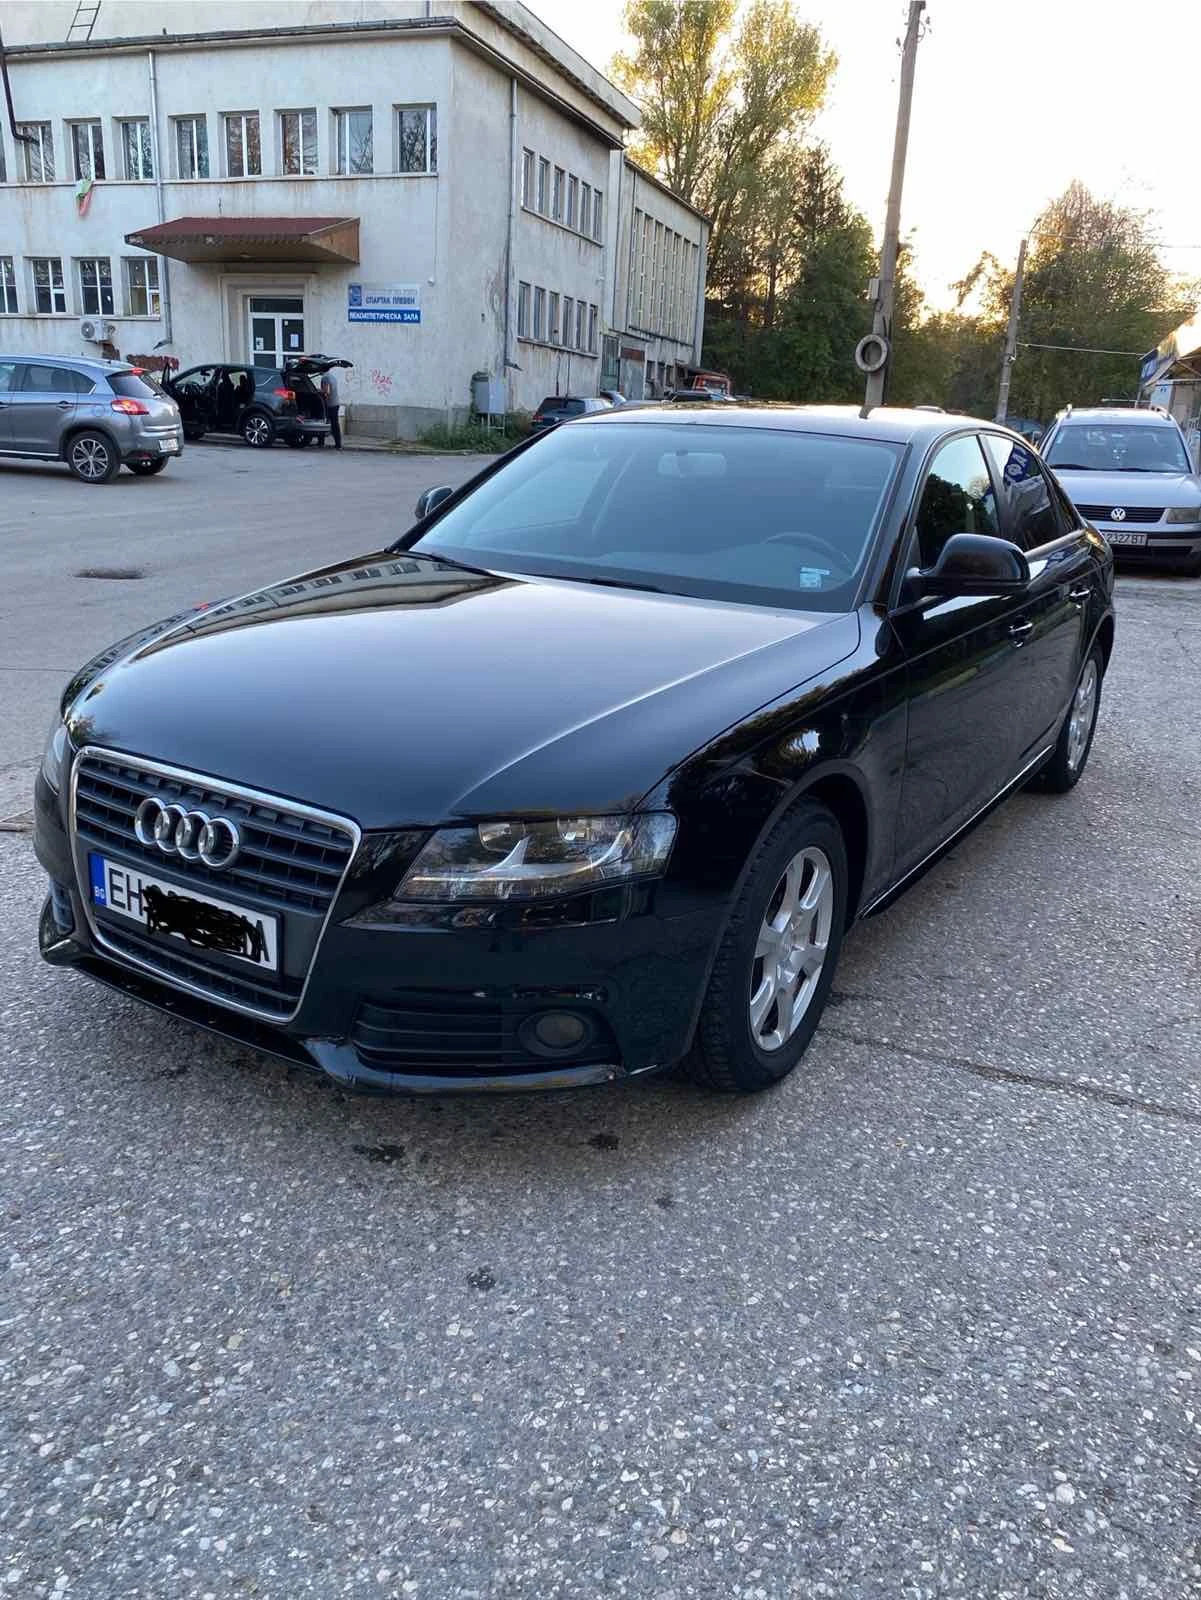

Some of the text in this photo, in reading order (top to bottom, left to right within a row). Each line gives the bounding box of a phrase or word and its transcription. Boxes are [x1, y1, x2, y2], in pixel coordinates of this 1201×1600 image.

[365, 296, 391, 305] СПАРТАК
[403, 312, 419, 321] ЗАЛА
[93, 885, 105, 900] BG
[108, 867, 144, 917] EH
